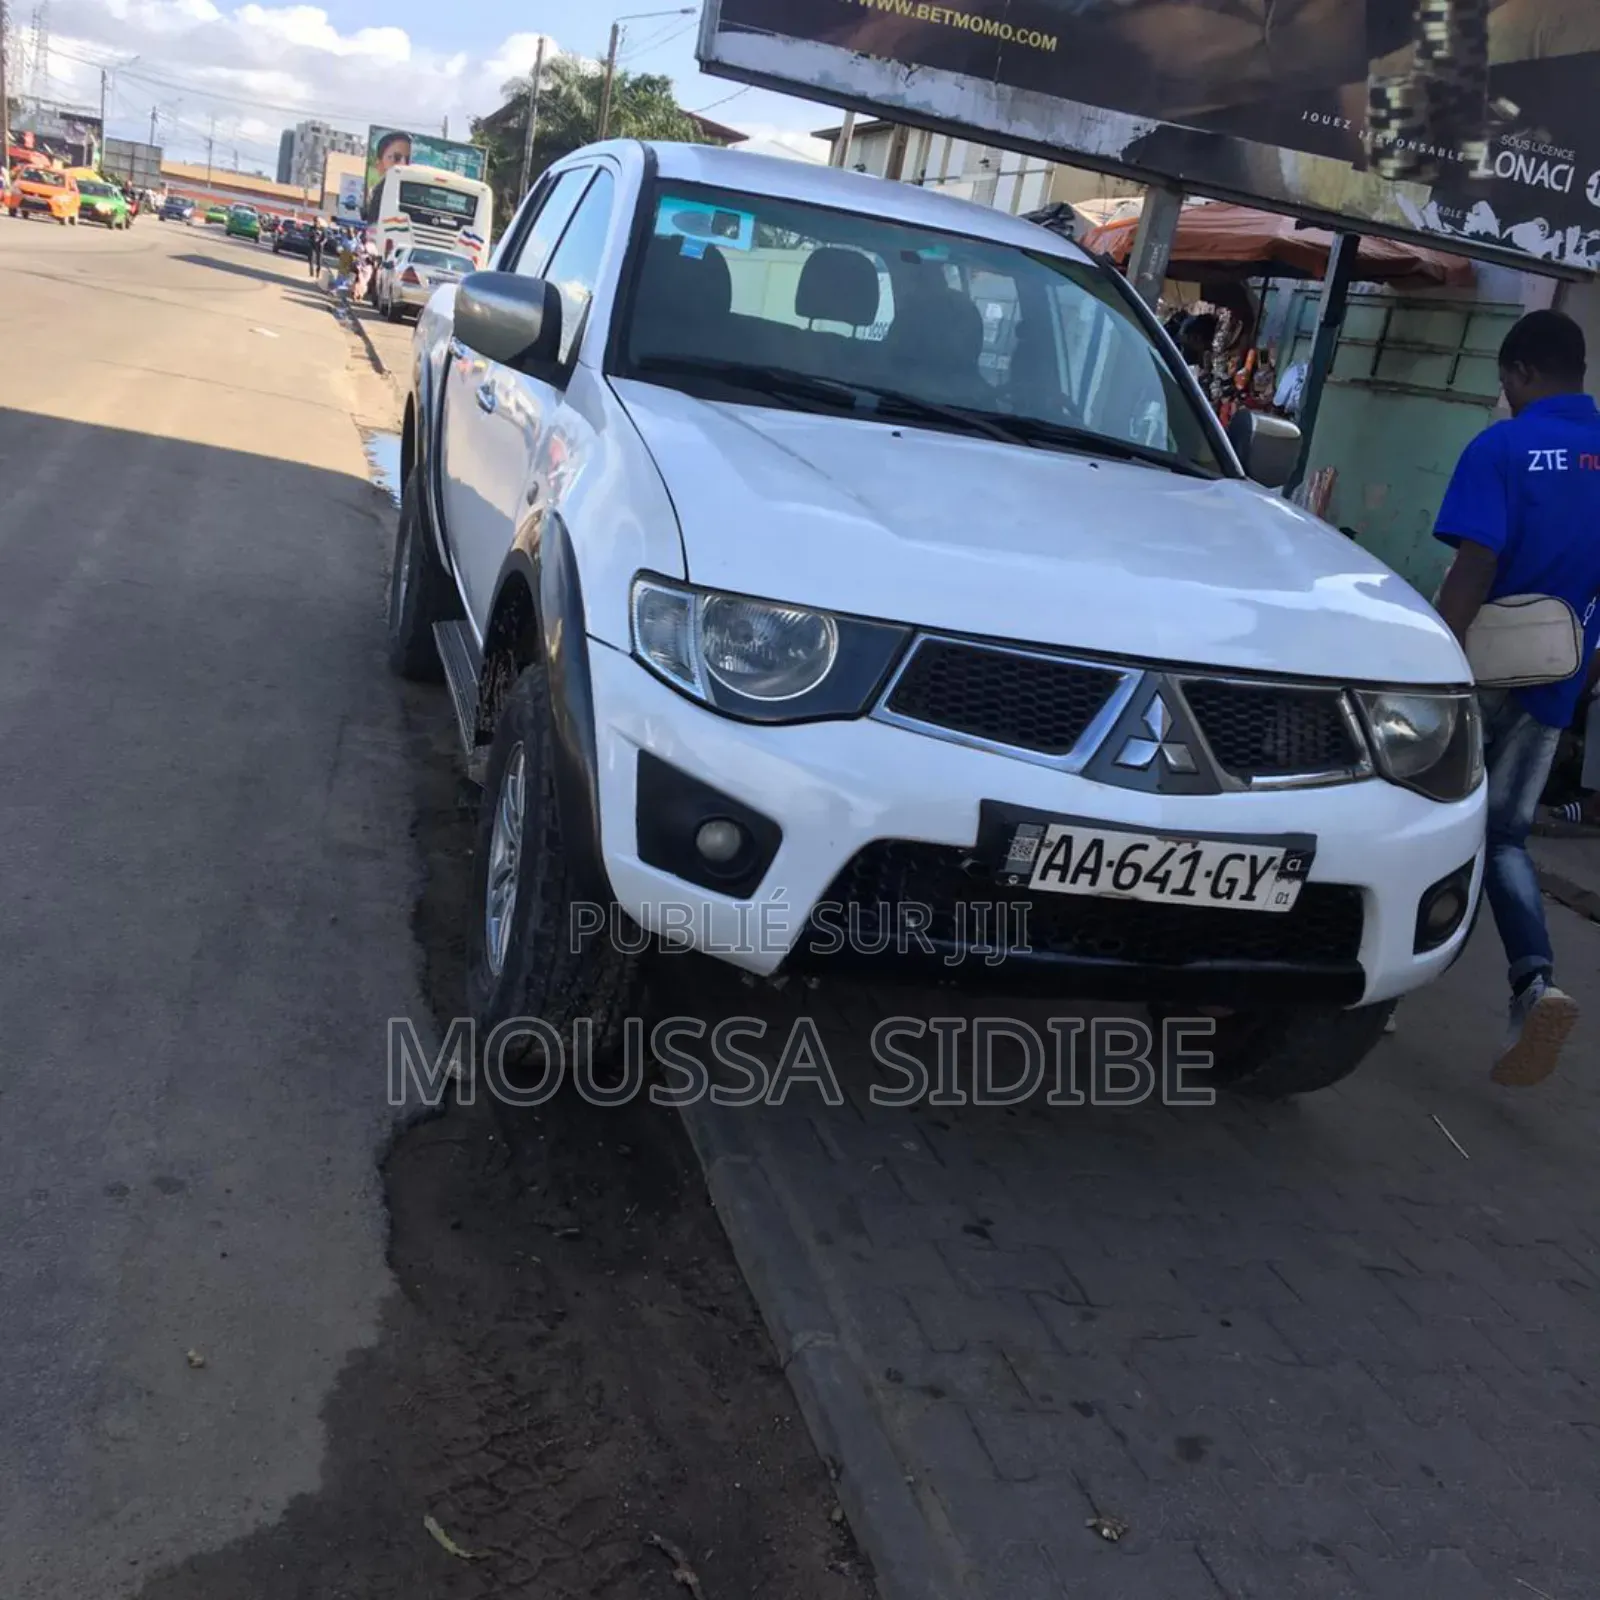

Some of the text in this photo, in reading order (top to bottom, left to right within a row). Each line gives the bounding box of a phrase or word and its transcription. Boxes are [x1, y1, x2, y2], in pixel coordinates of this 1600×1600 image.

[1301, 110, 1352, 130] JOUEZ
[1501, 134, 1576, 161] SOUS LICENCE
[1528, 448, 1568, 471] ZTE
[1286, 858, 1302, 872] CI
[1275, 891, 1290, 904] 01
